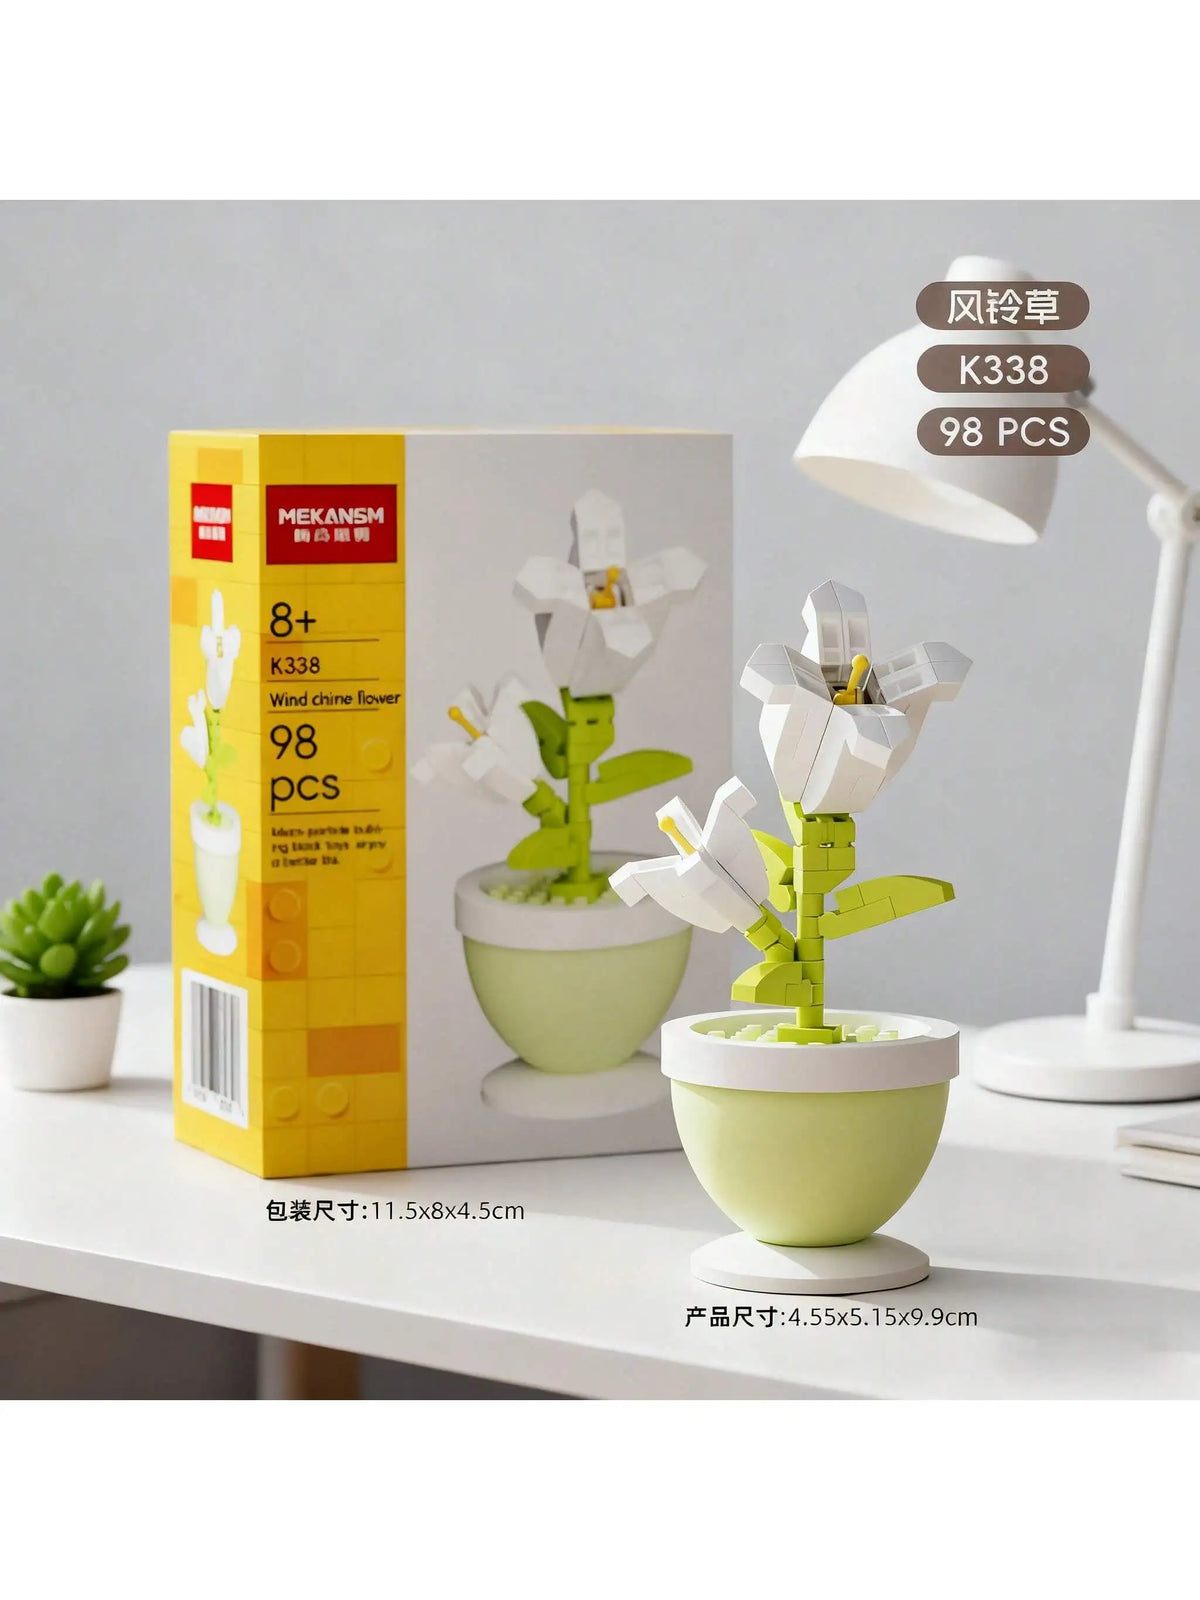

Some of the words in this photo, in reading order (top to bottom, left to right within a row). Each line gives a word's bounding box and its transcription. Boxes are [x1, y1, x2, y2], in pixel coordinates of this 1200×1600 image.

[270, 601, 317, 638] 8+
[270, 656, 321, 676] K338
[269, 690, 308, 708] Wind
[357, 689, 402, 706] flower
[270, 723, 318, 760] 98
[271, 774, 340, 813] pcs
